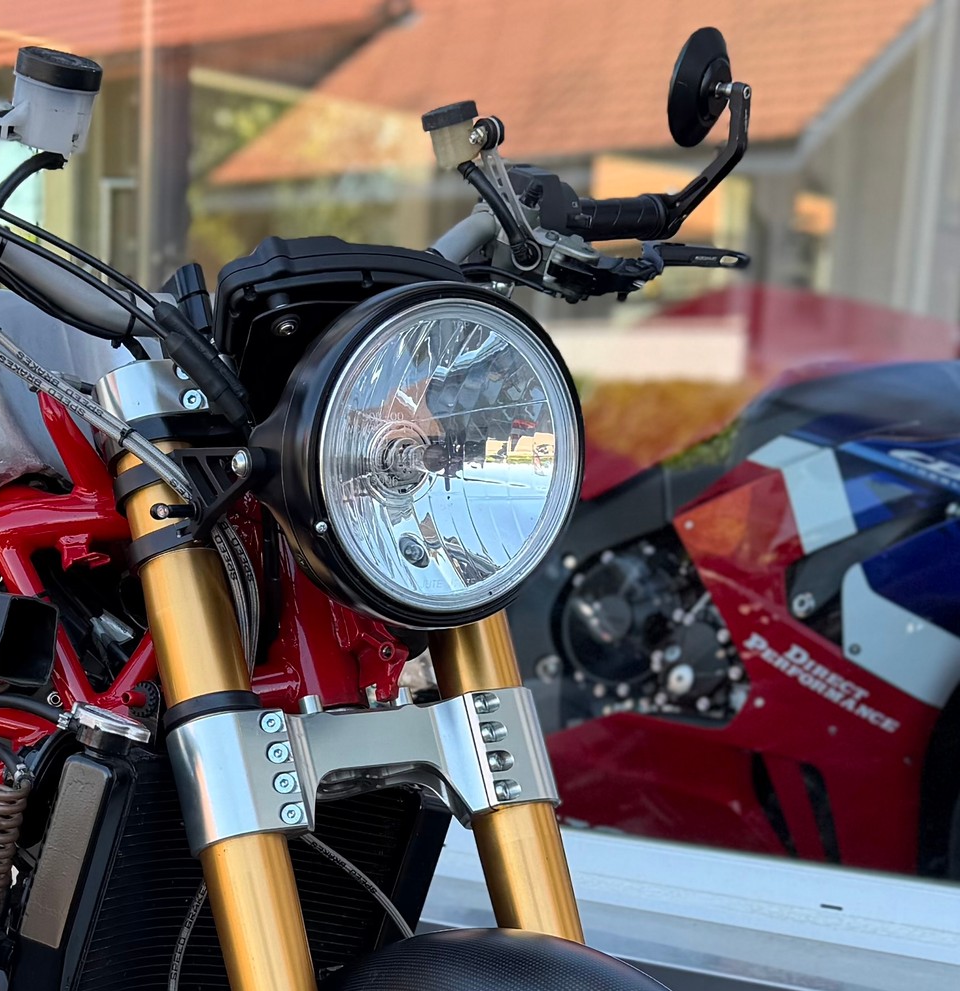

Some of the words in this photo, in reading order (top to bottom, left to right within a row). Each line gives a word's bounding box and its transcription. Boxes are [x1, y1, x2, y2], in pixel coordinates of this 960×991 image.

[0, 354, 42, 386] BRAKES
[16, 350, 60, 387] BRAKES
[47, 387, 86, 417] SPEED
[65, 387, 104, 417] SPEED
[214, 533, 238, 581] SPEED
[231, 536, 254, 582] SPEED
[742, 632, 901, 734] PERFORMANCE
[783, 643, 870, 700] DIRECT
